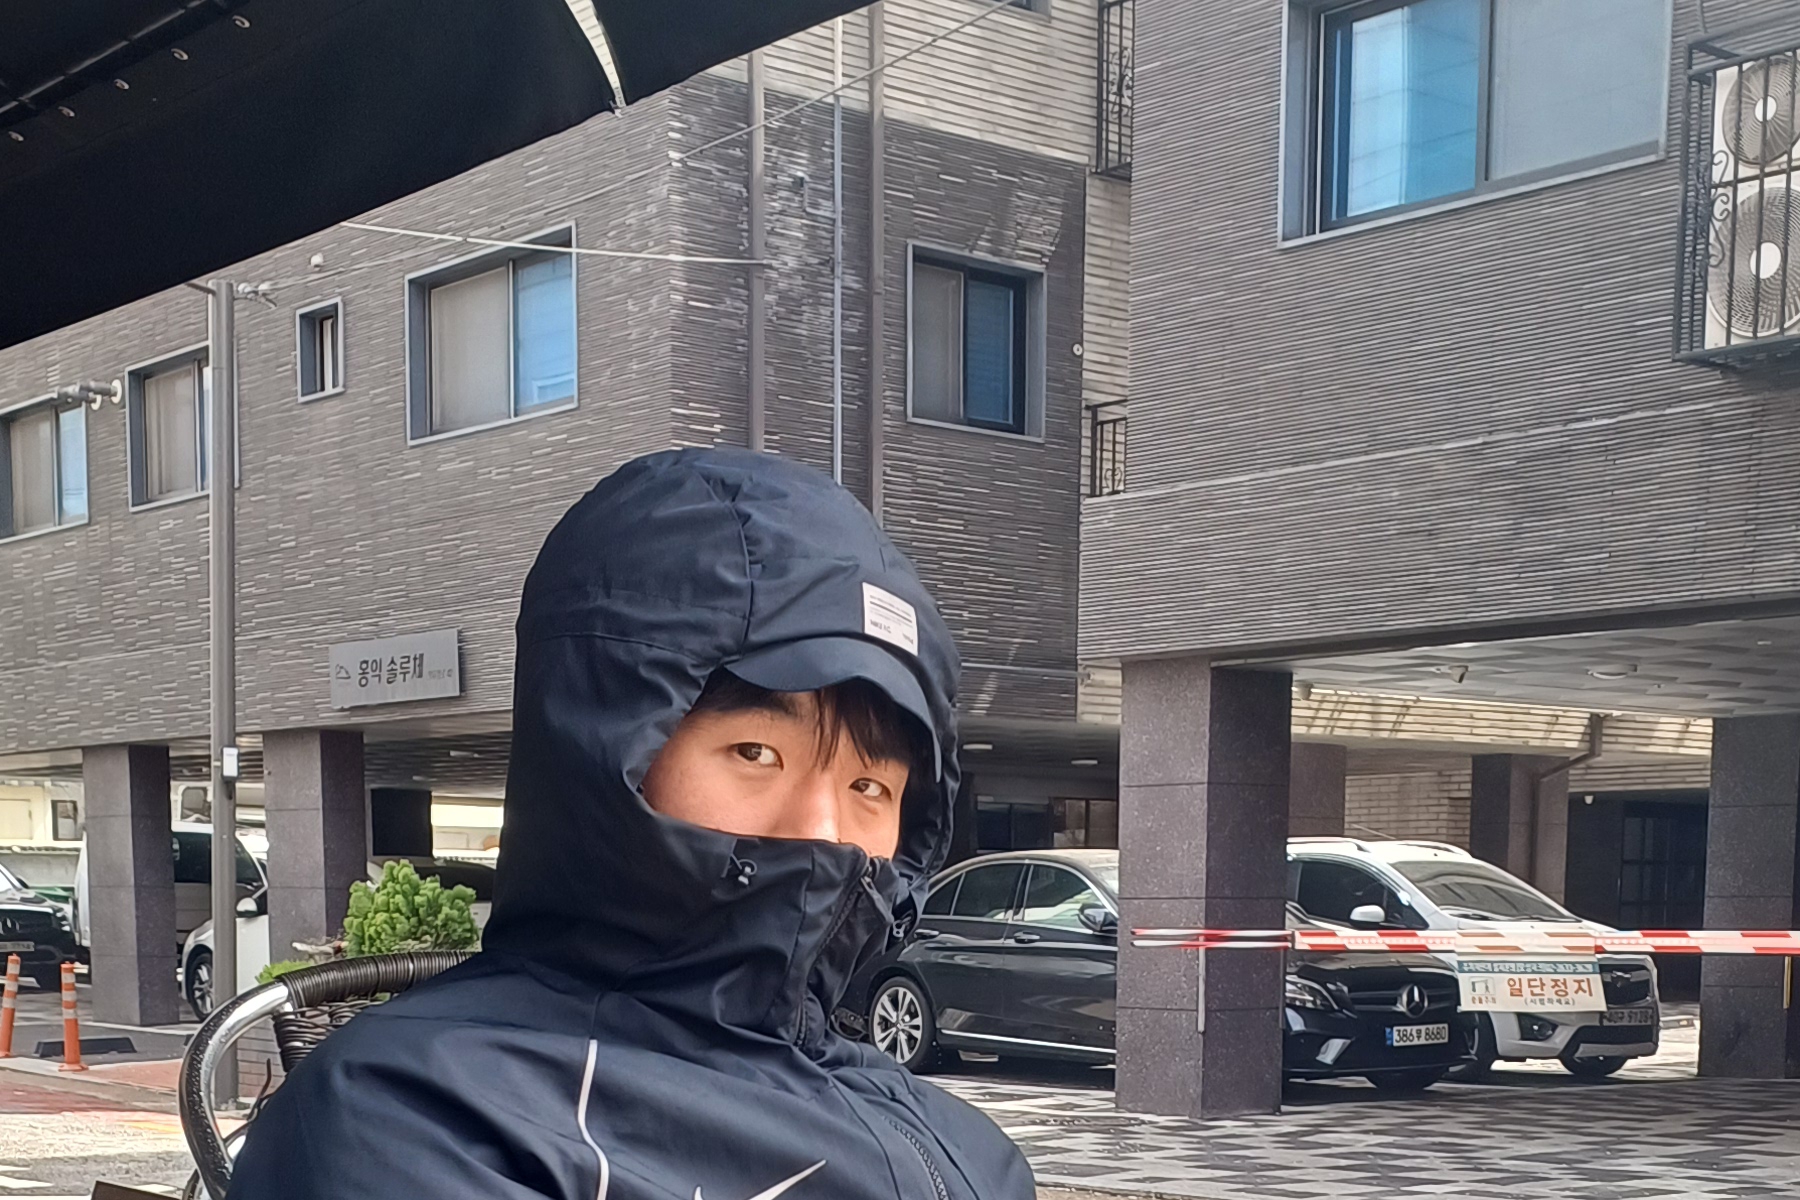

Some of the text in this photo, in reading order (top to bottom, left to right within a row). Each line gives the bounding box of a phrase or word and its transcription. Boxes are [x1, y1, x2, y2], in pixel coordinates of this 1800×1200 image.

[358, 657, 382, 688] 홍익
[1507, 977, 1594, 998] 일단정지
[1395, 1028, 1422, 1043] 386무
